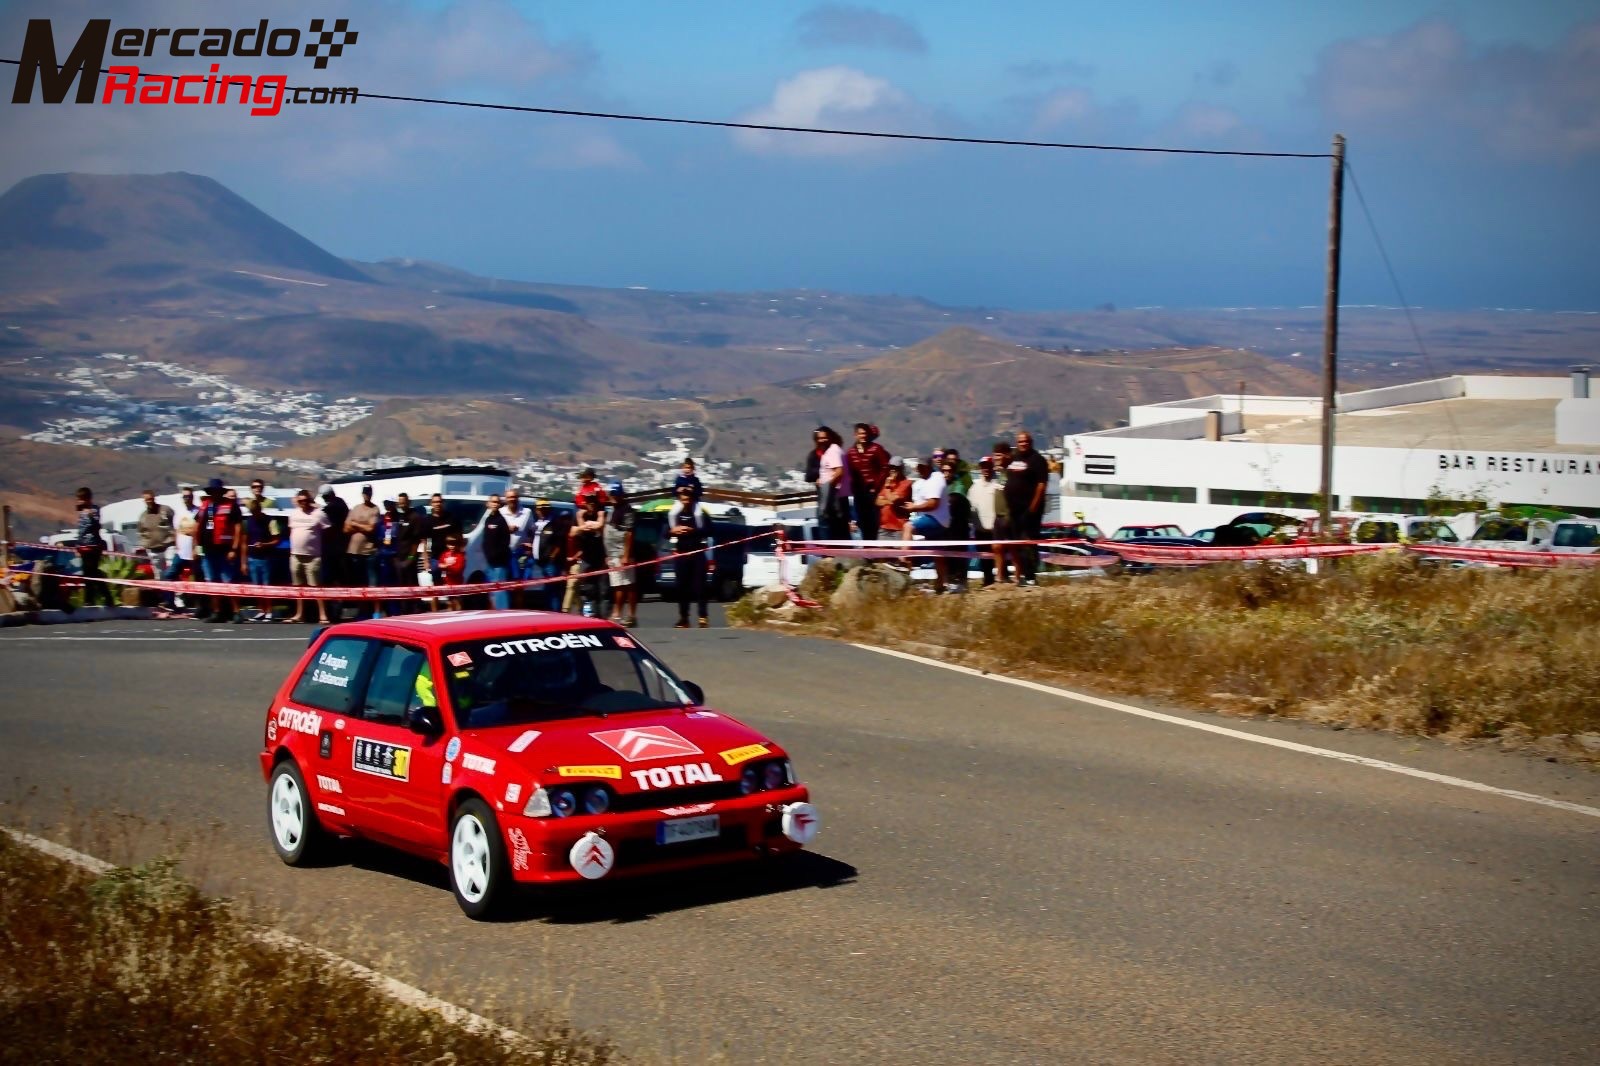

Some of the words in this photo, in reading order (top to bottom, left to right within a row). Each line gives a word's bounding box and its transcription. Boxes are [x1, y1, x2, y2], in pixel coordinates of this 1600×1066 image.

[1438, 454, 1476, 471] BAR
[483, 633, 604, 658] CITROËN
[462, 752, 497, 776] TOTAL
[316, 774, 343, 794] TOTAL
[629, 762, 724, 791] TOTAL
